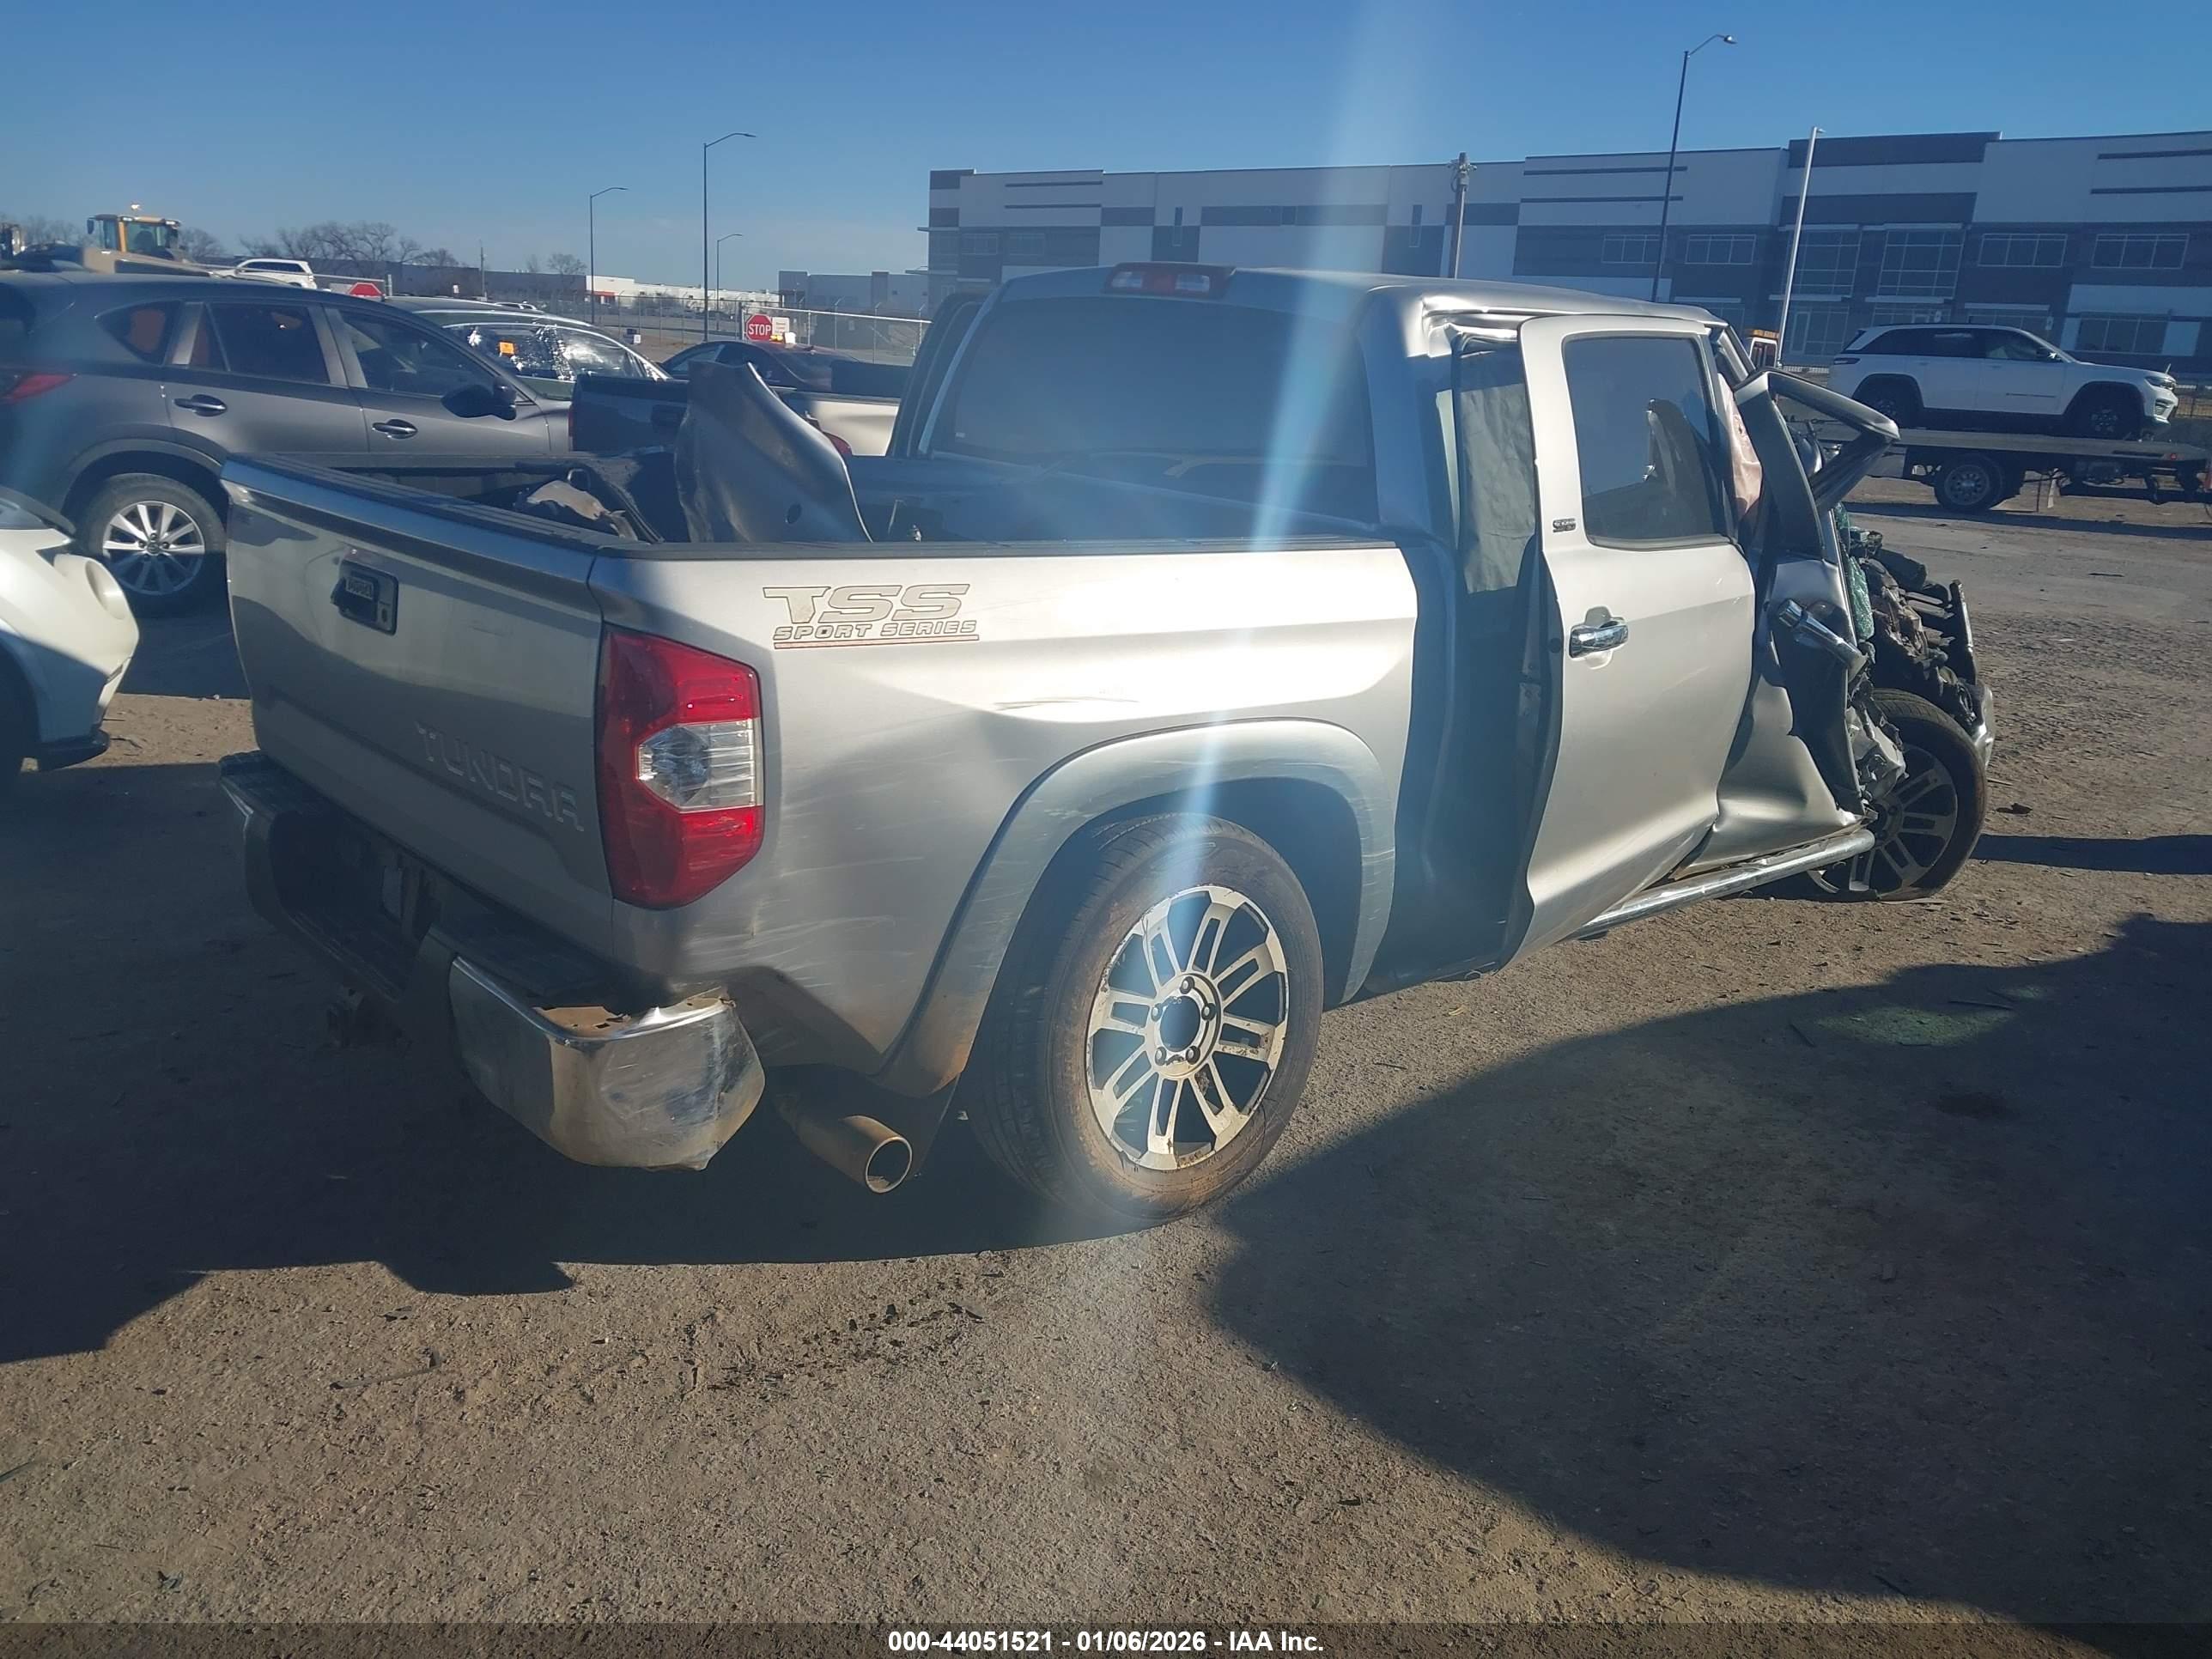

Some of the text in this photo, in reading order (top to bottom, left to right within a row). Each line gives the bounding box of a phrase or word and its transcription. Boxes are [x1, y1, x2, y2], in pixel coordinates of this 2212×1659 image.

[748, 323, 771, 336] STOP
[762, 583, 970, 624] TSS
[772, 619, 977, 641] SPORT SERIES
[415, 720, 585, 832] TUNDRA
